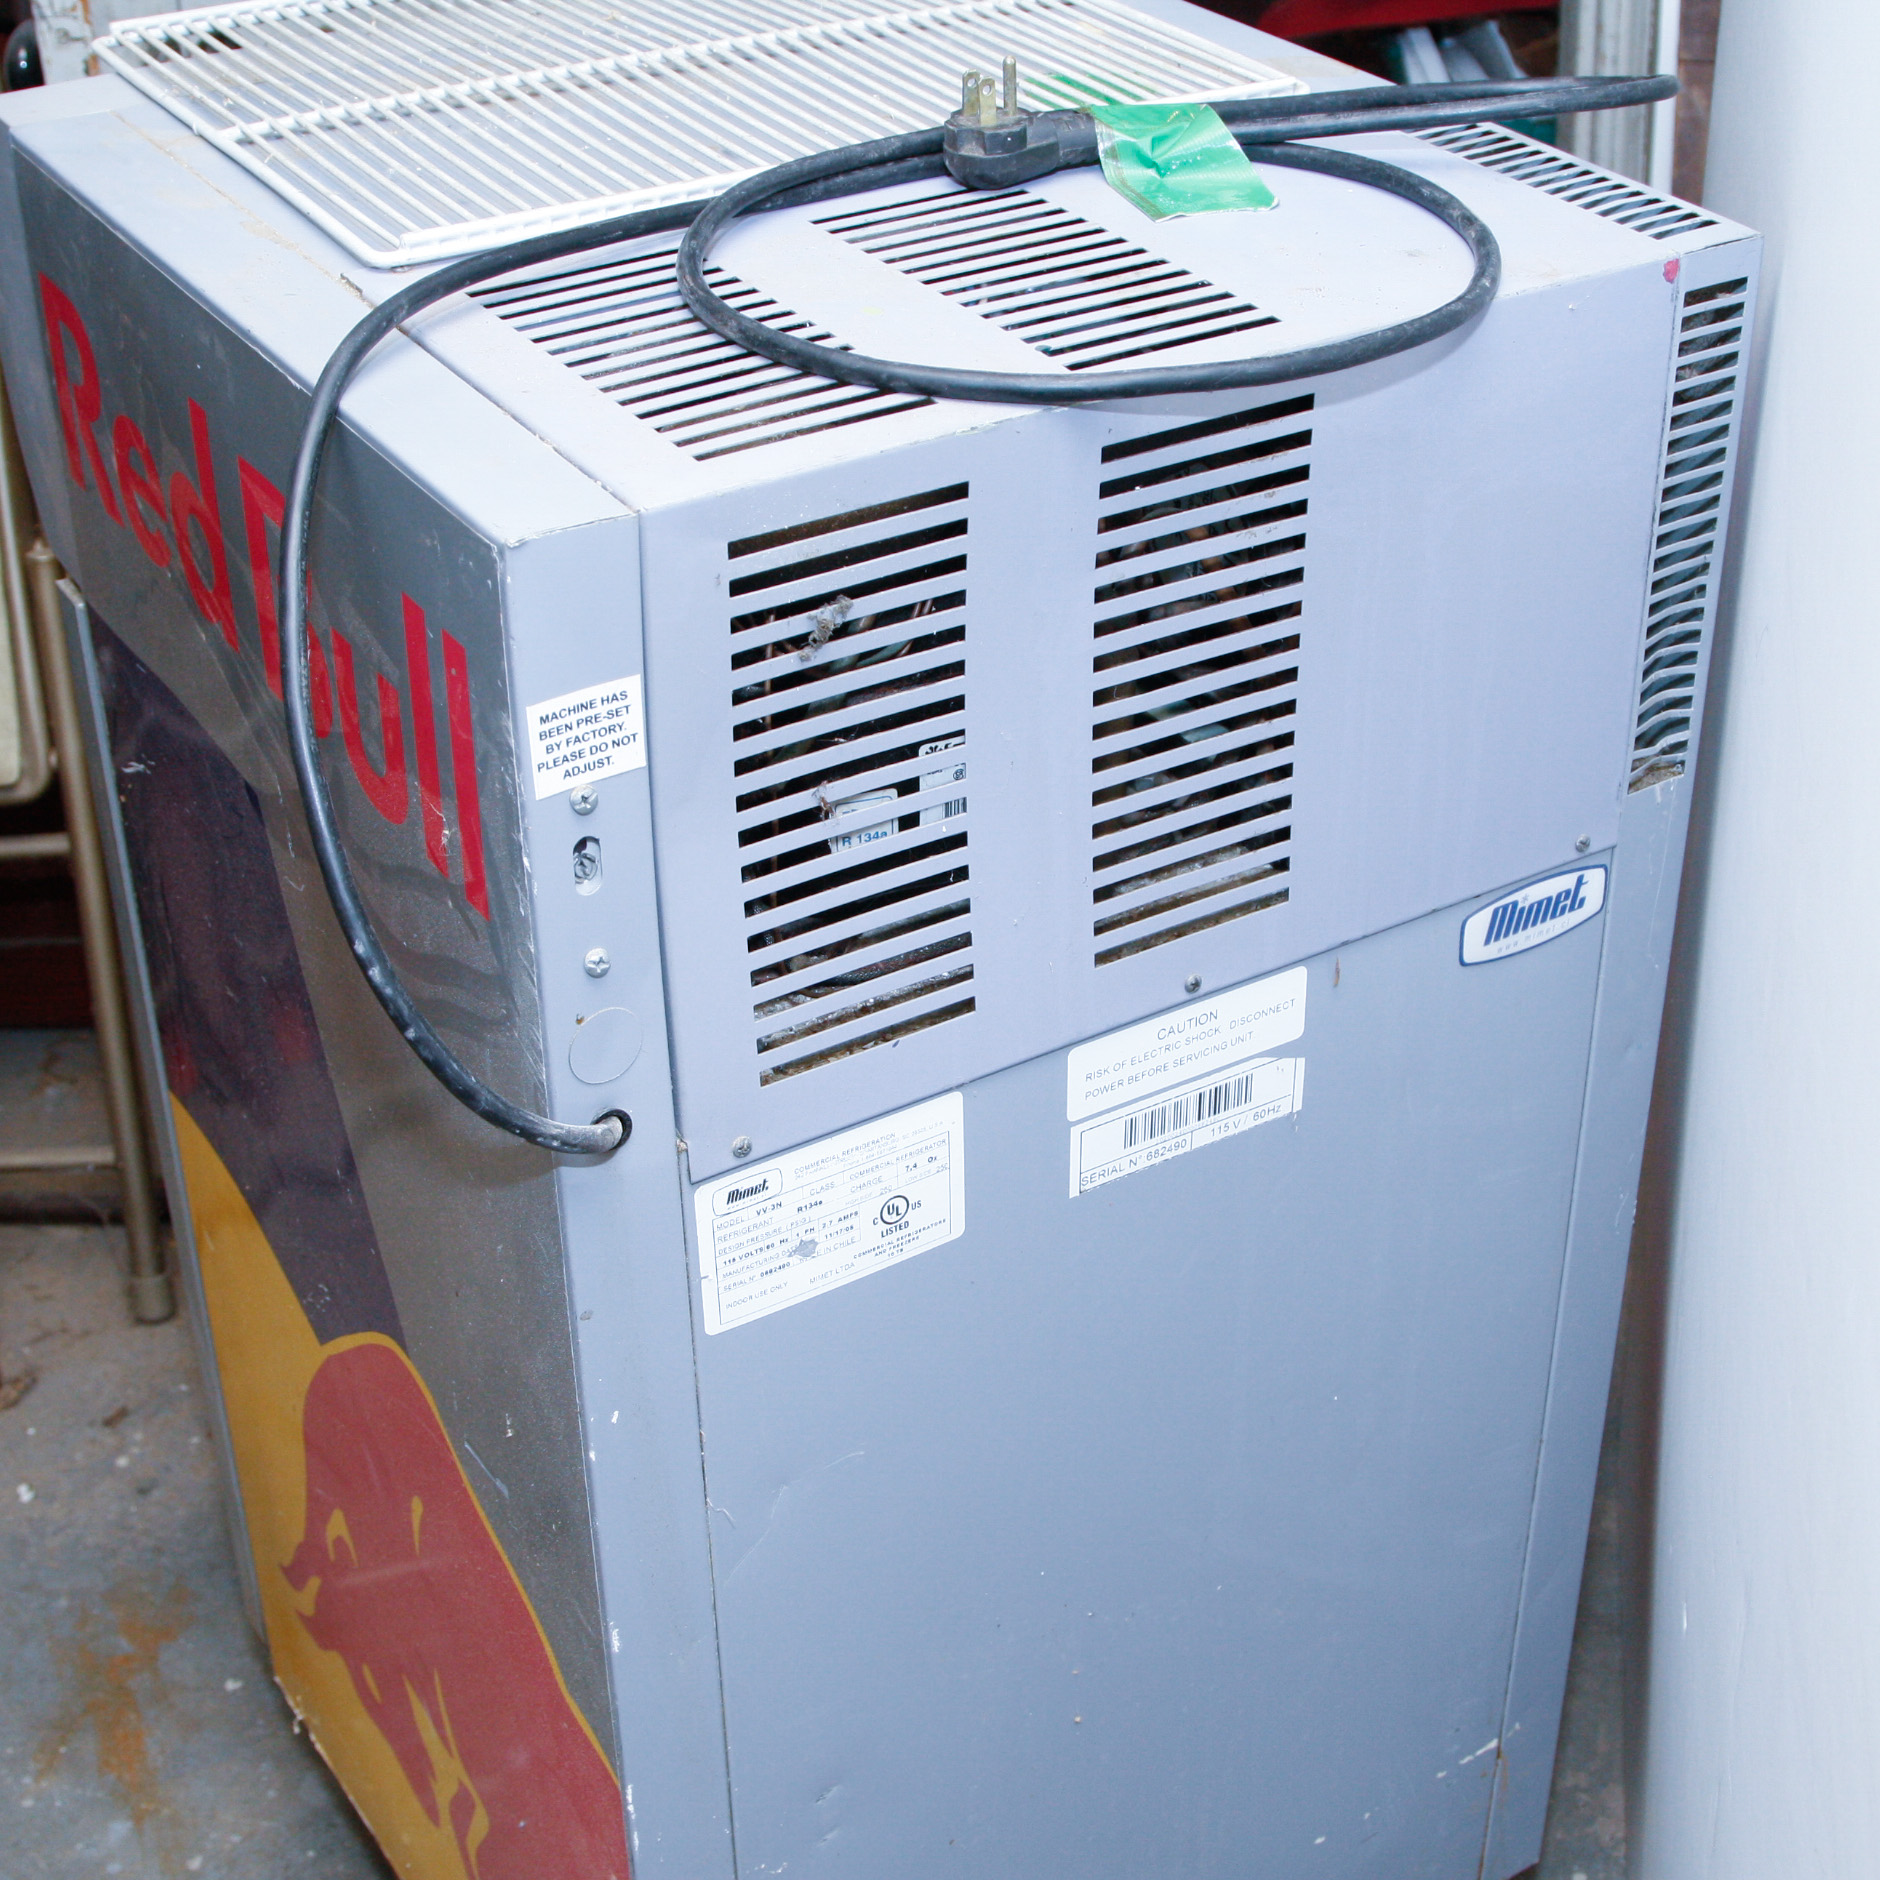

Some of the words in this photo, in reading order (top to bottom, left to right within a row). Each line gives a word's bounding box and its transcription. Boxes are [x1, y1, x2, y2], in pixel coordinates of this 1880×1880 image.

[38, 272, 241, 653] Red
[539, 699, 597, 725] MACHINE
[601, 691, 628, 706] HAS
[539, 722, 572, 741] BEEN
[577, 704, 631, 729] PRE-SET
[538, 748, 586, 772] PLEASE
[590, 742, 608, 755] DO
[612, 733, 638, 748] NOT
[546, 741, 562, 754] BY
[566, 722, 626, 748] FACTORY.
[564, 756, 614, 780] ADJUST.
[1484, 874, 1589, 947] Mimet
[1085, 1065, 1110, 1082] RISK
[1113, 1058, 1128, 1073] OF
[1131, 1041, 1181, 1067] ELECTRIC
[1229, 999, 1295, 1030] DISCONNECT
[1157, 1009, 1219, 1040] CAUTION
[1085, 1079, 1124, 1101] POWER
[1127, 1063, 1169, 1085] BEFORE
[1173, 1041, 1227, 1068] SERVICING
[1211, 1123, 1229, 1137] 115
[1233, 1119, 1242, 1130] V
[1253, 1103, 1281, 1122] 60Hz
[794, 1155, 840, 1175] COMMERCIAL
[842, 1133, 895, 1156] REFRIGERATION
[717, 1216, 744, 1230] MODEL
[810, 1181, 835, 1196] CLASS
[849, 1159, 894, 1180] COMMERCIAL
[897, 1139, 946, 1162] REFRIGERATOR
[1081, 1164, 1125, 1187] SERIAL
[717, 1217, 774, 1243] REFRIGERANT
[850, 1176, 883, 1193] CHARGE
[911, 1200, 922, 1211] US
[719, 1242, 744, 1255] DESIGN
[747, 1226, 782, 1244] PRESSURE
[881, 1221, 909, 1238] LISTED
[723, 1253, 779, 1278] MANUFACTURING
[724, 1279, 747, 1291] SERIAL
[834, 1237, 856, 1250] CHILE
[739, 1247, 763, 1260] VOLTS
[726, 1295, 753, 1309] INDOOR
[755, 1289, 769, 1298] USE
[770, 1282, 788, 1293] ONLY
